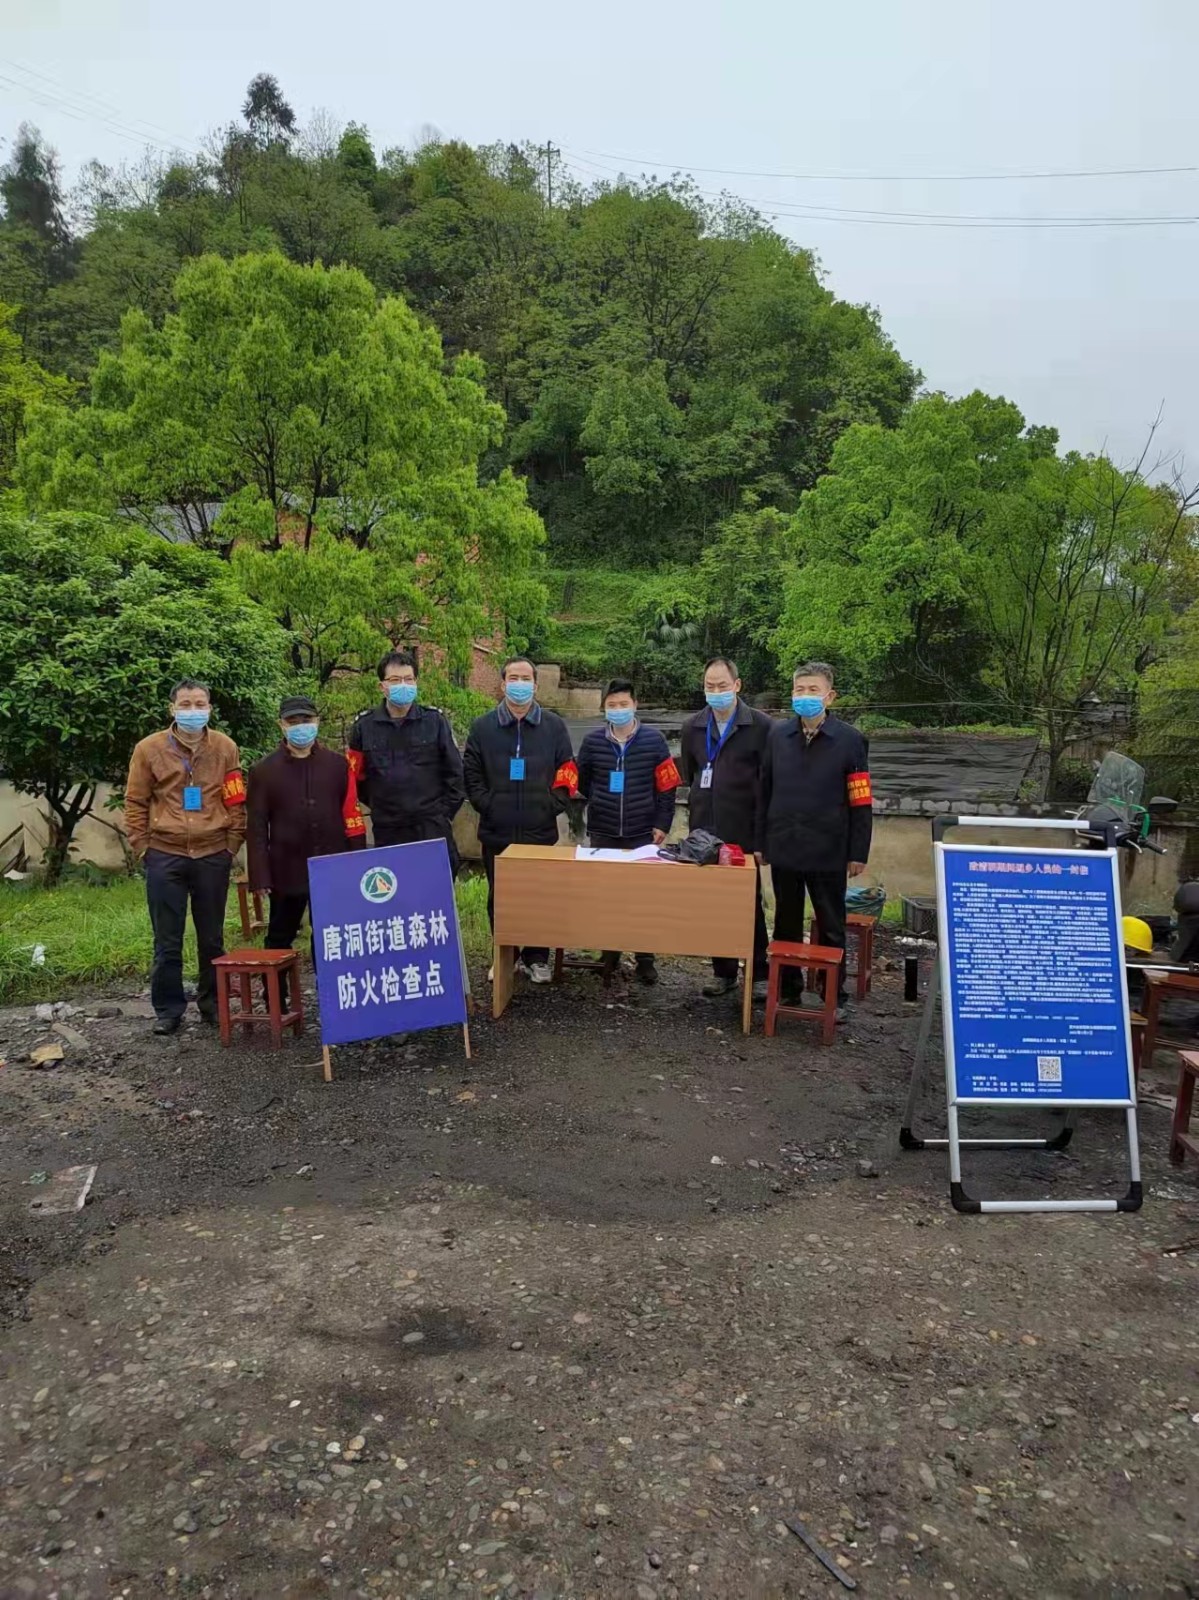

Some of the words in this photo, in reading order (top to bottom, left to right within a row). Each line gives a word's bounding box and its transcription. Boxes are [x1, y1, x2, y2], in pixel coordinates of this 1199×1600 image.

[322, 909, 449, 961] 唐洞街道森林
[337, 959, 445, 1010] 防火检查点
